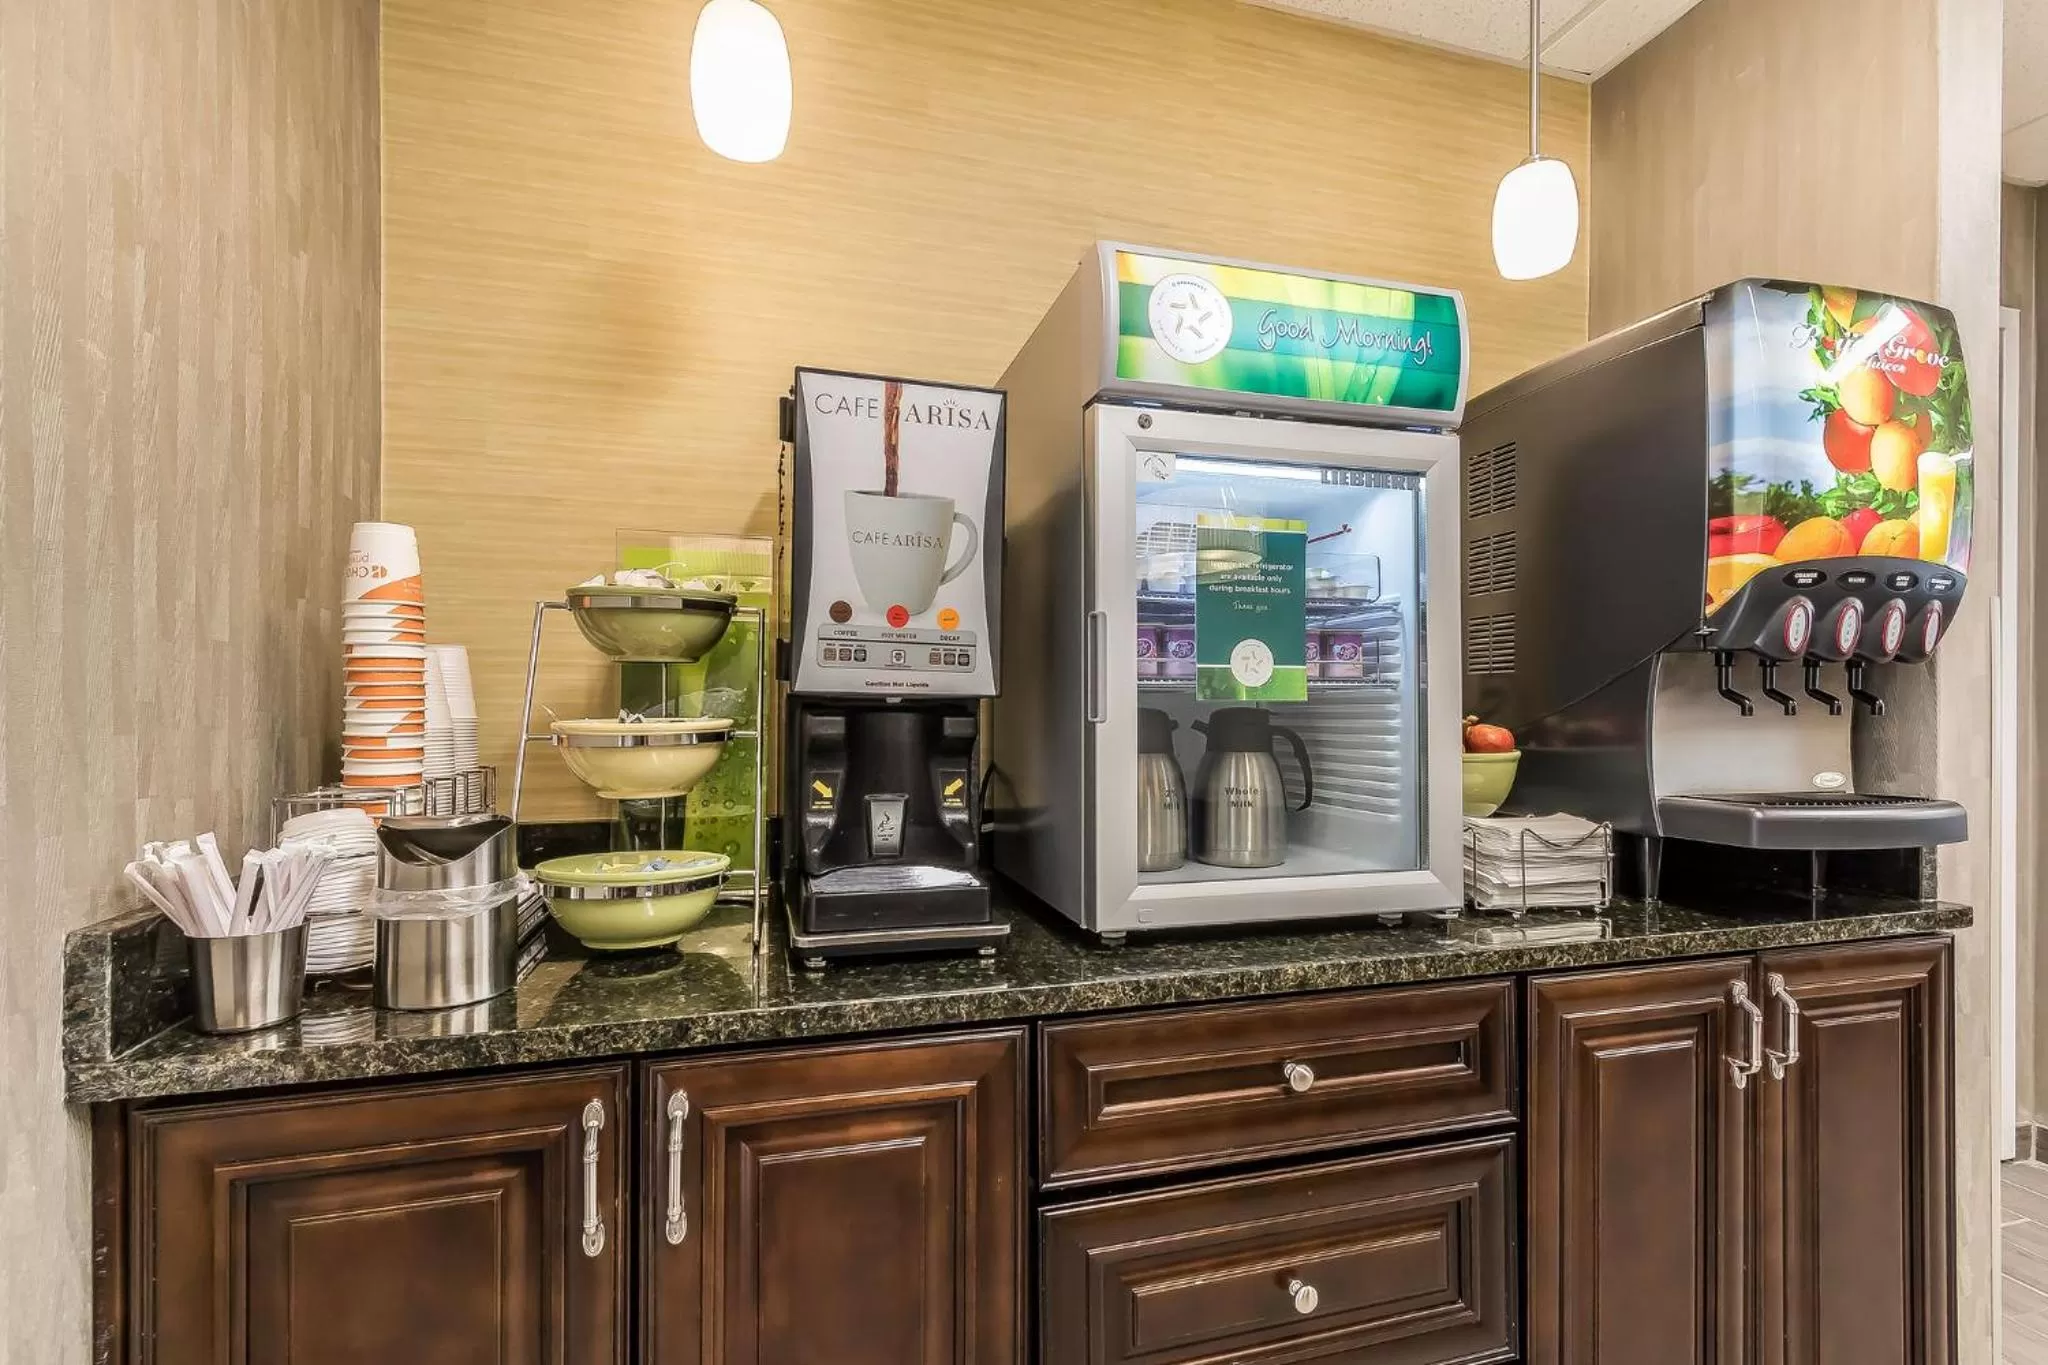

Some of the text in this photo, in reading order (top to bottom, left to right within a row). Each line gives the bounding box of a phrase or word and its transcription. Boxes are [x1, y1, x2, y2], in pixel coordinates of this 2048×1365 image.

[1257, 308, 1314, 351] Good
[1320, 317, 1434, 365] Morning!
[1884, 335, 1950, 368] Grove
[814, 392, 992, 431] CAFE ARISA
[1320, 468, 1421, 492] LIEBHERR
[852, 530, 944, 550] CAFE ARISA
[1224, 786, 1259, 796] Whole
[1230, 800, 1254, 809] Milk
